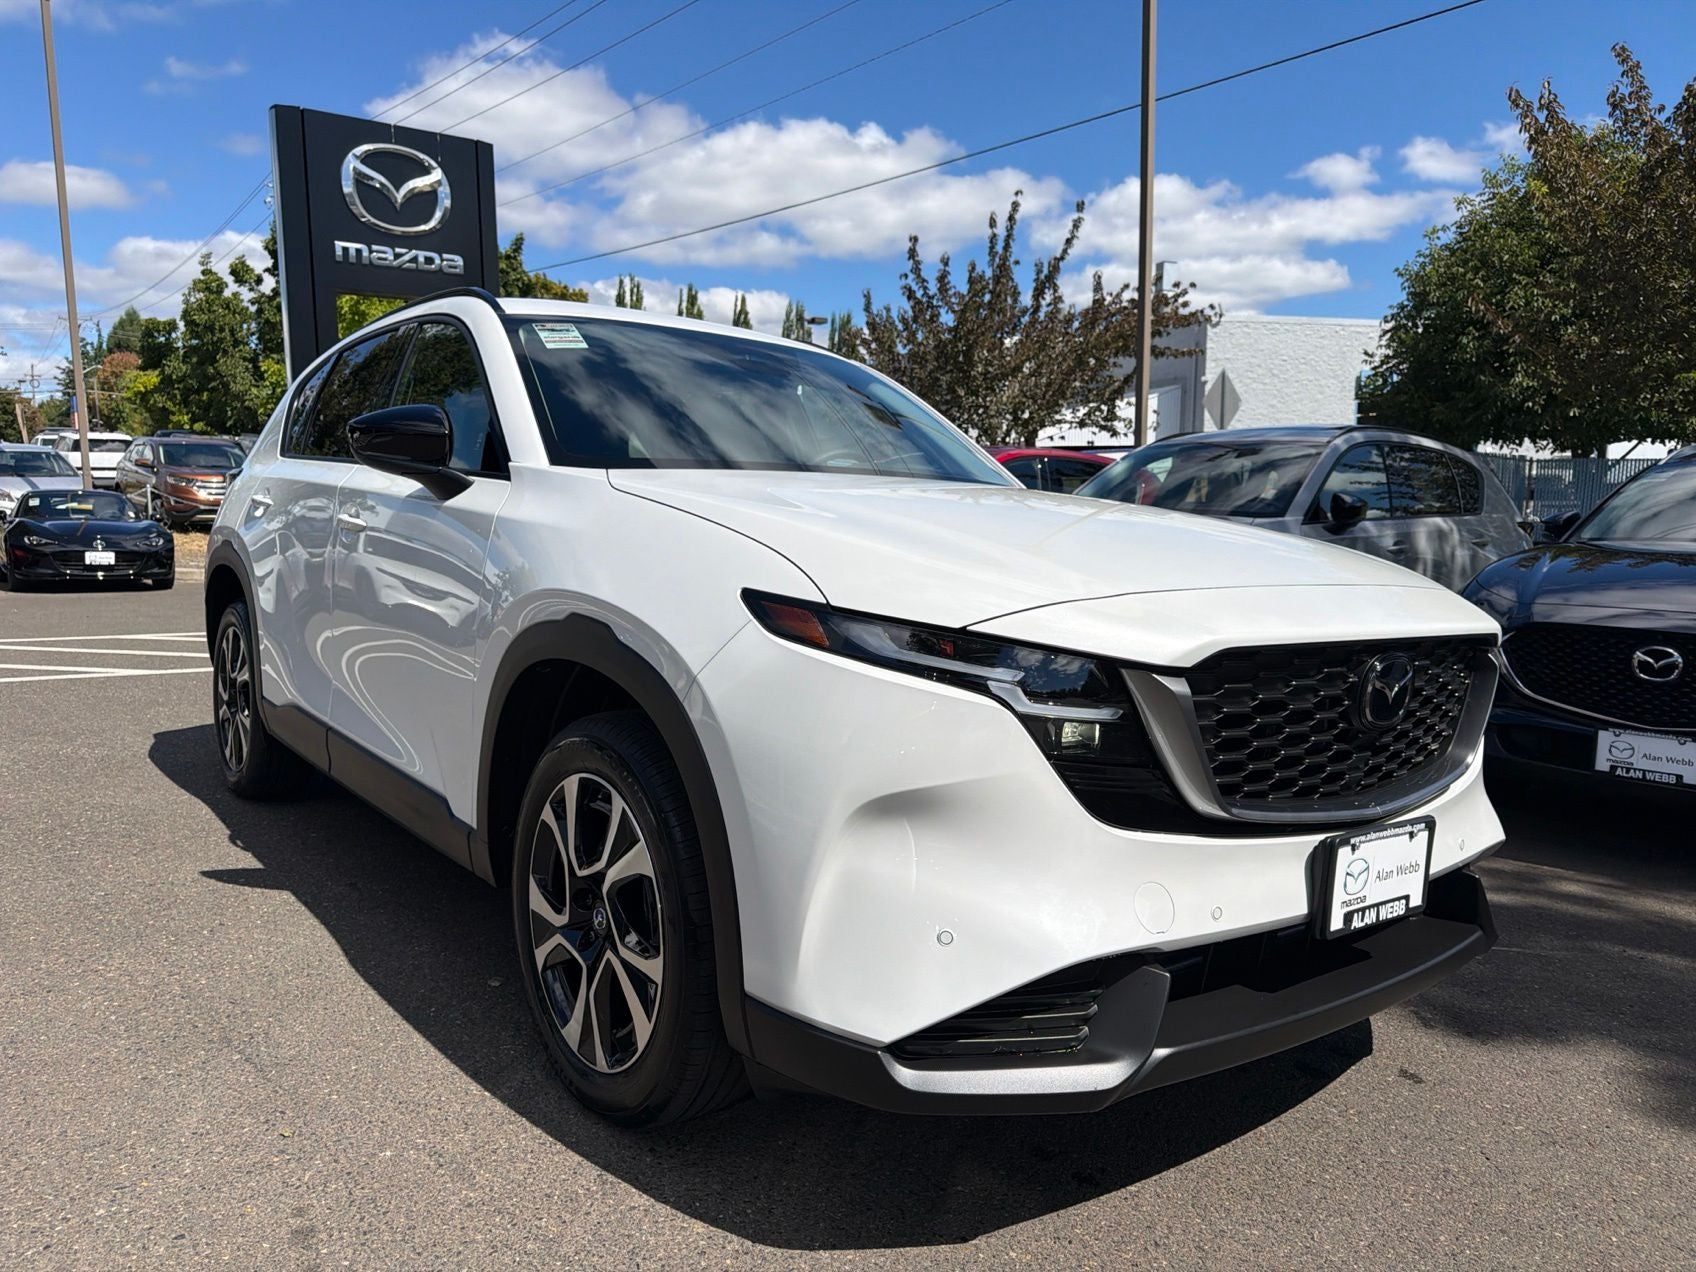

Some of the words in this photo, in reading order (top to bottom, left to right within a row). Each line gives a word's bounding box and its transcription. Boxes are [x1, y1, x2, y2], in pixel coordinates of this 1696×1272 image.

[1641, 753, 1663, 763] Alan
[1666, 756, 1694, 767] Webb
[1615, 767, 1643, 779] ALAN
[1645, 771, 1677, 784] WEBB
[1375, 869, 1394, 883] Alan
[1396, 860, 1420, 877] Webb
[1351, 906, 1377, 930] ALAN
[1379, 899, 1406, 921] WEBB
